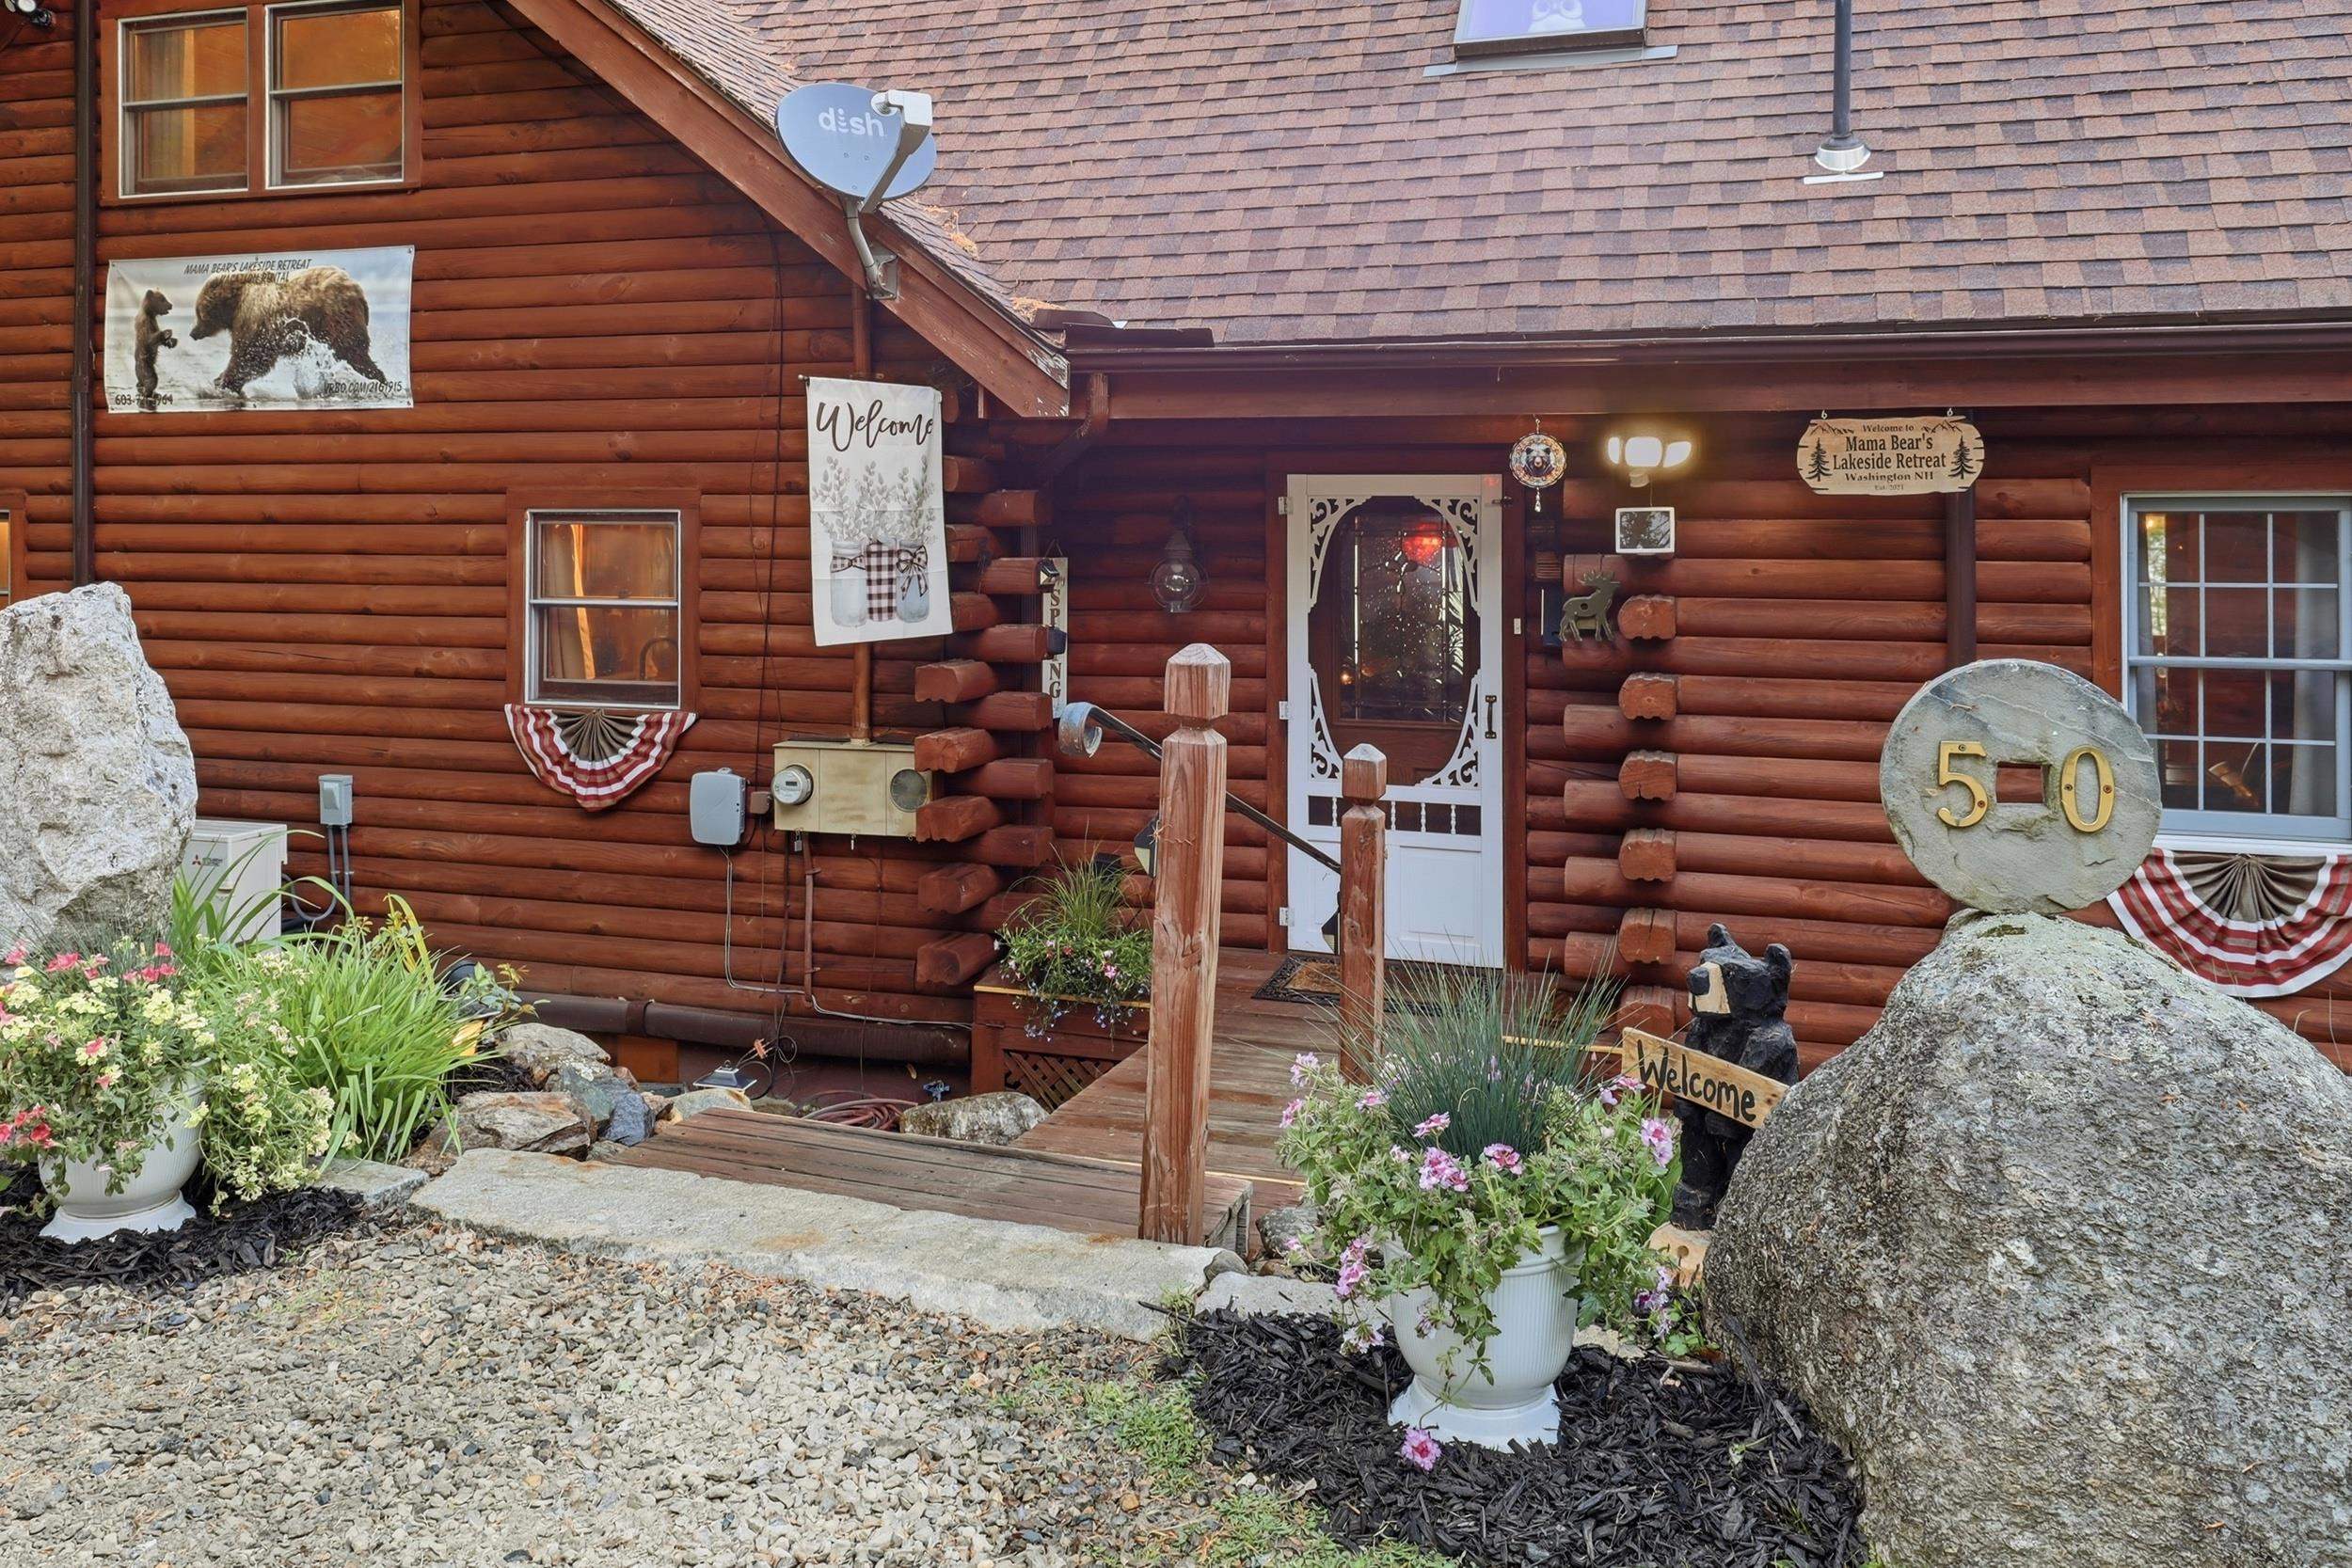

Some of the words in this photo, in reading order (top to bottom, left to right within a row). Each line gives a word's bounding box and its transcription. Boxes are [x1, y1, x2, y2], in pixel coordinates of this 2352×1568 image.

[818, 106, 885, 137] dish
[183, 263, 210, 275] MAMA
[239, 261, 276, 272] LAKESIDE
[277, 259, 312, 271] RETREAT
[816, 399, 934, 452] Welcome
[1862, 424, 1903, 433] Welcome
[1846, 436, 1886, 451] Mama
[1890, 433, 1933, 451] Bear's
[1833, 452, 1893, 470] Lakeside
[1896, 451, 1947, 469] Retreat
[1845, 472, 1912, 483] Washington
[1915, 471, 1933, 481] NH
[1049, 589, 1061, 699] SPNG
[1637, 1038, 1756, 1122] Welcome
